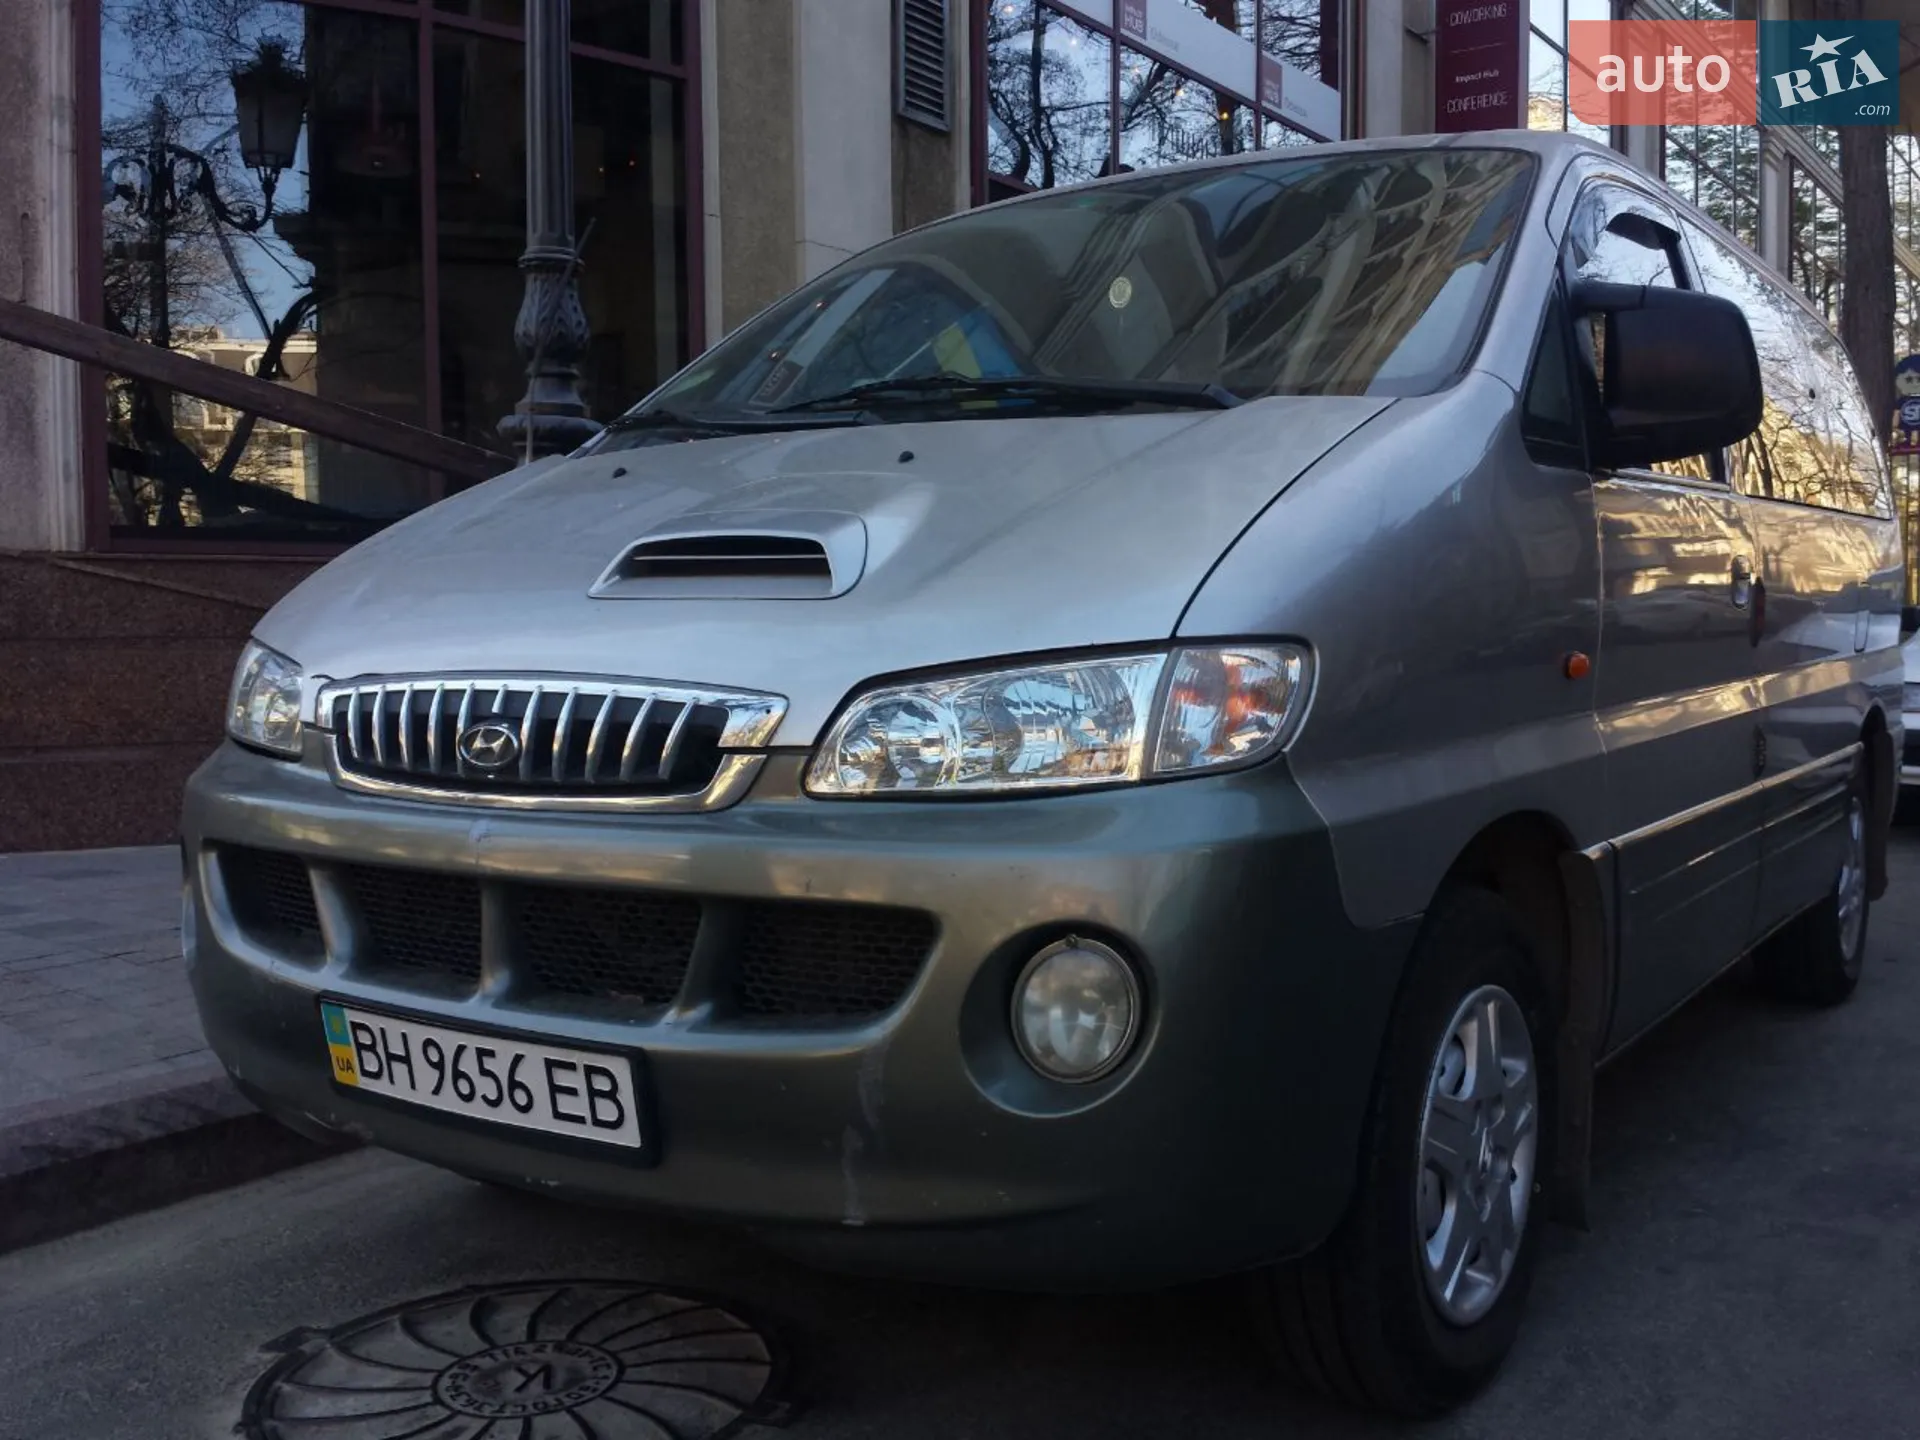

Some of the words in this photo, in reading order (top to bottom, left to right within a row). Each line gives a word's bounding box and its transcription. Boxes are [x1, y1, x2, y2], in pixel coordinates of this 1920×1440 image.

[1450, 3, 1507, 26] COWORKING
[1447, 91, 1508, 113] CONFERENCE
[336, 1057, 355, 1074] UA
[349, 1020, 417, 1091] BH
[422, 1037, 534, 1114] 9656
[544, 1056, 626, 1130] EB
